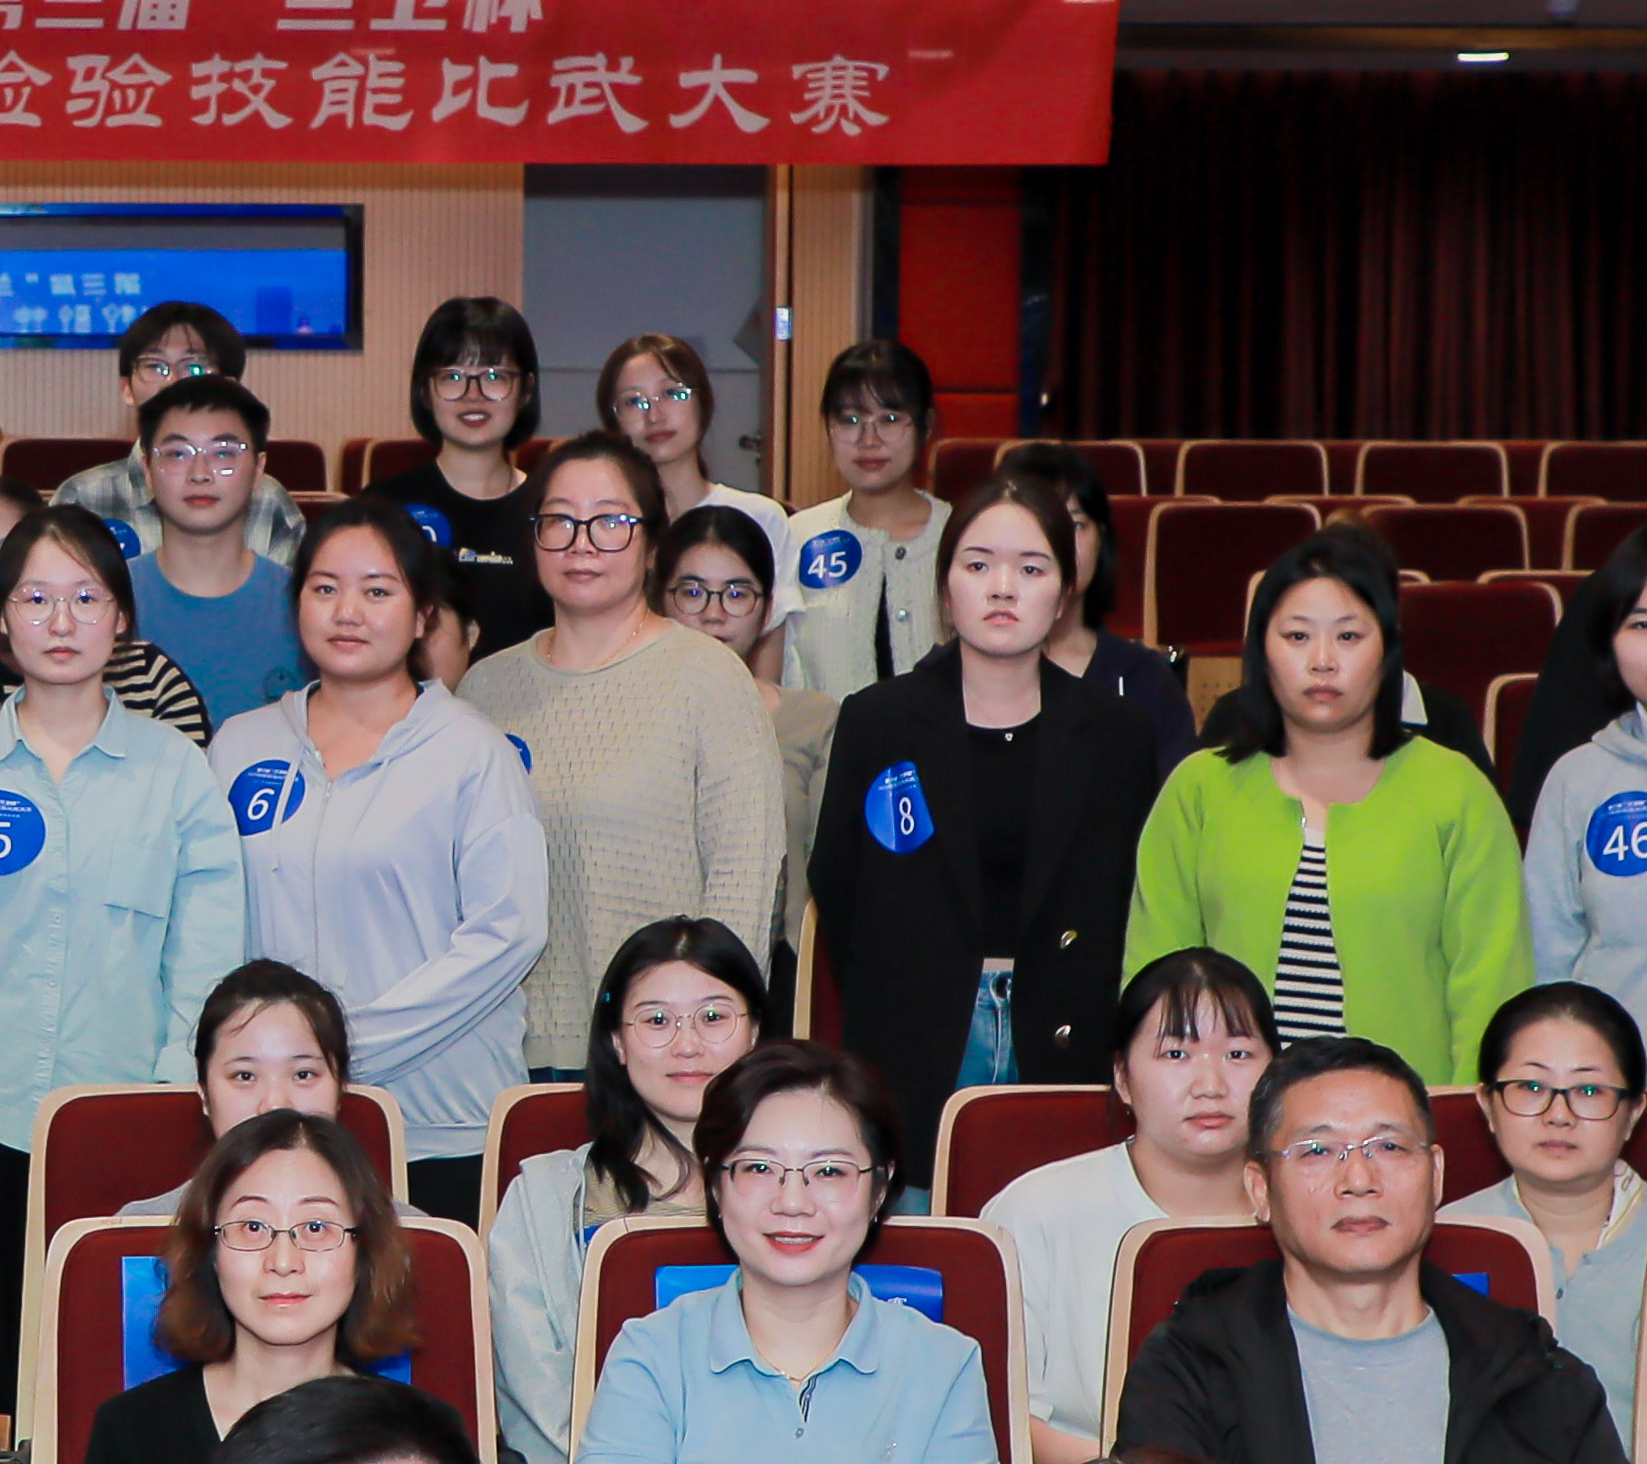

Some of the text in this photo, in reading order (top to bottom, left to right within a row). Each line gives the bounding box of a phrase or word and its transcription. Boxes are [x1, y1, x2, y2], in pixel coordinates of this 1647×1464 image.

[807, 550, 848, 579] 45
[247, 787, 275, 821] 6
[899, 796, 915, 835] 8
